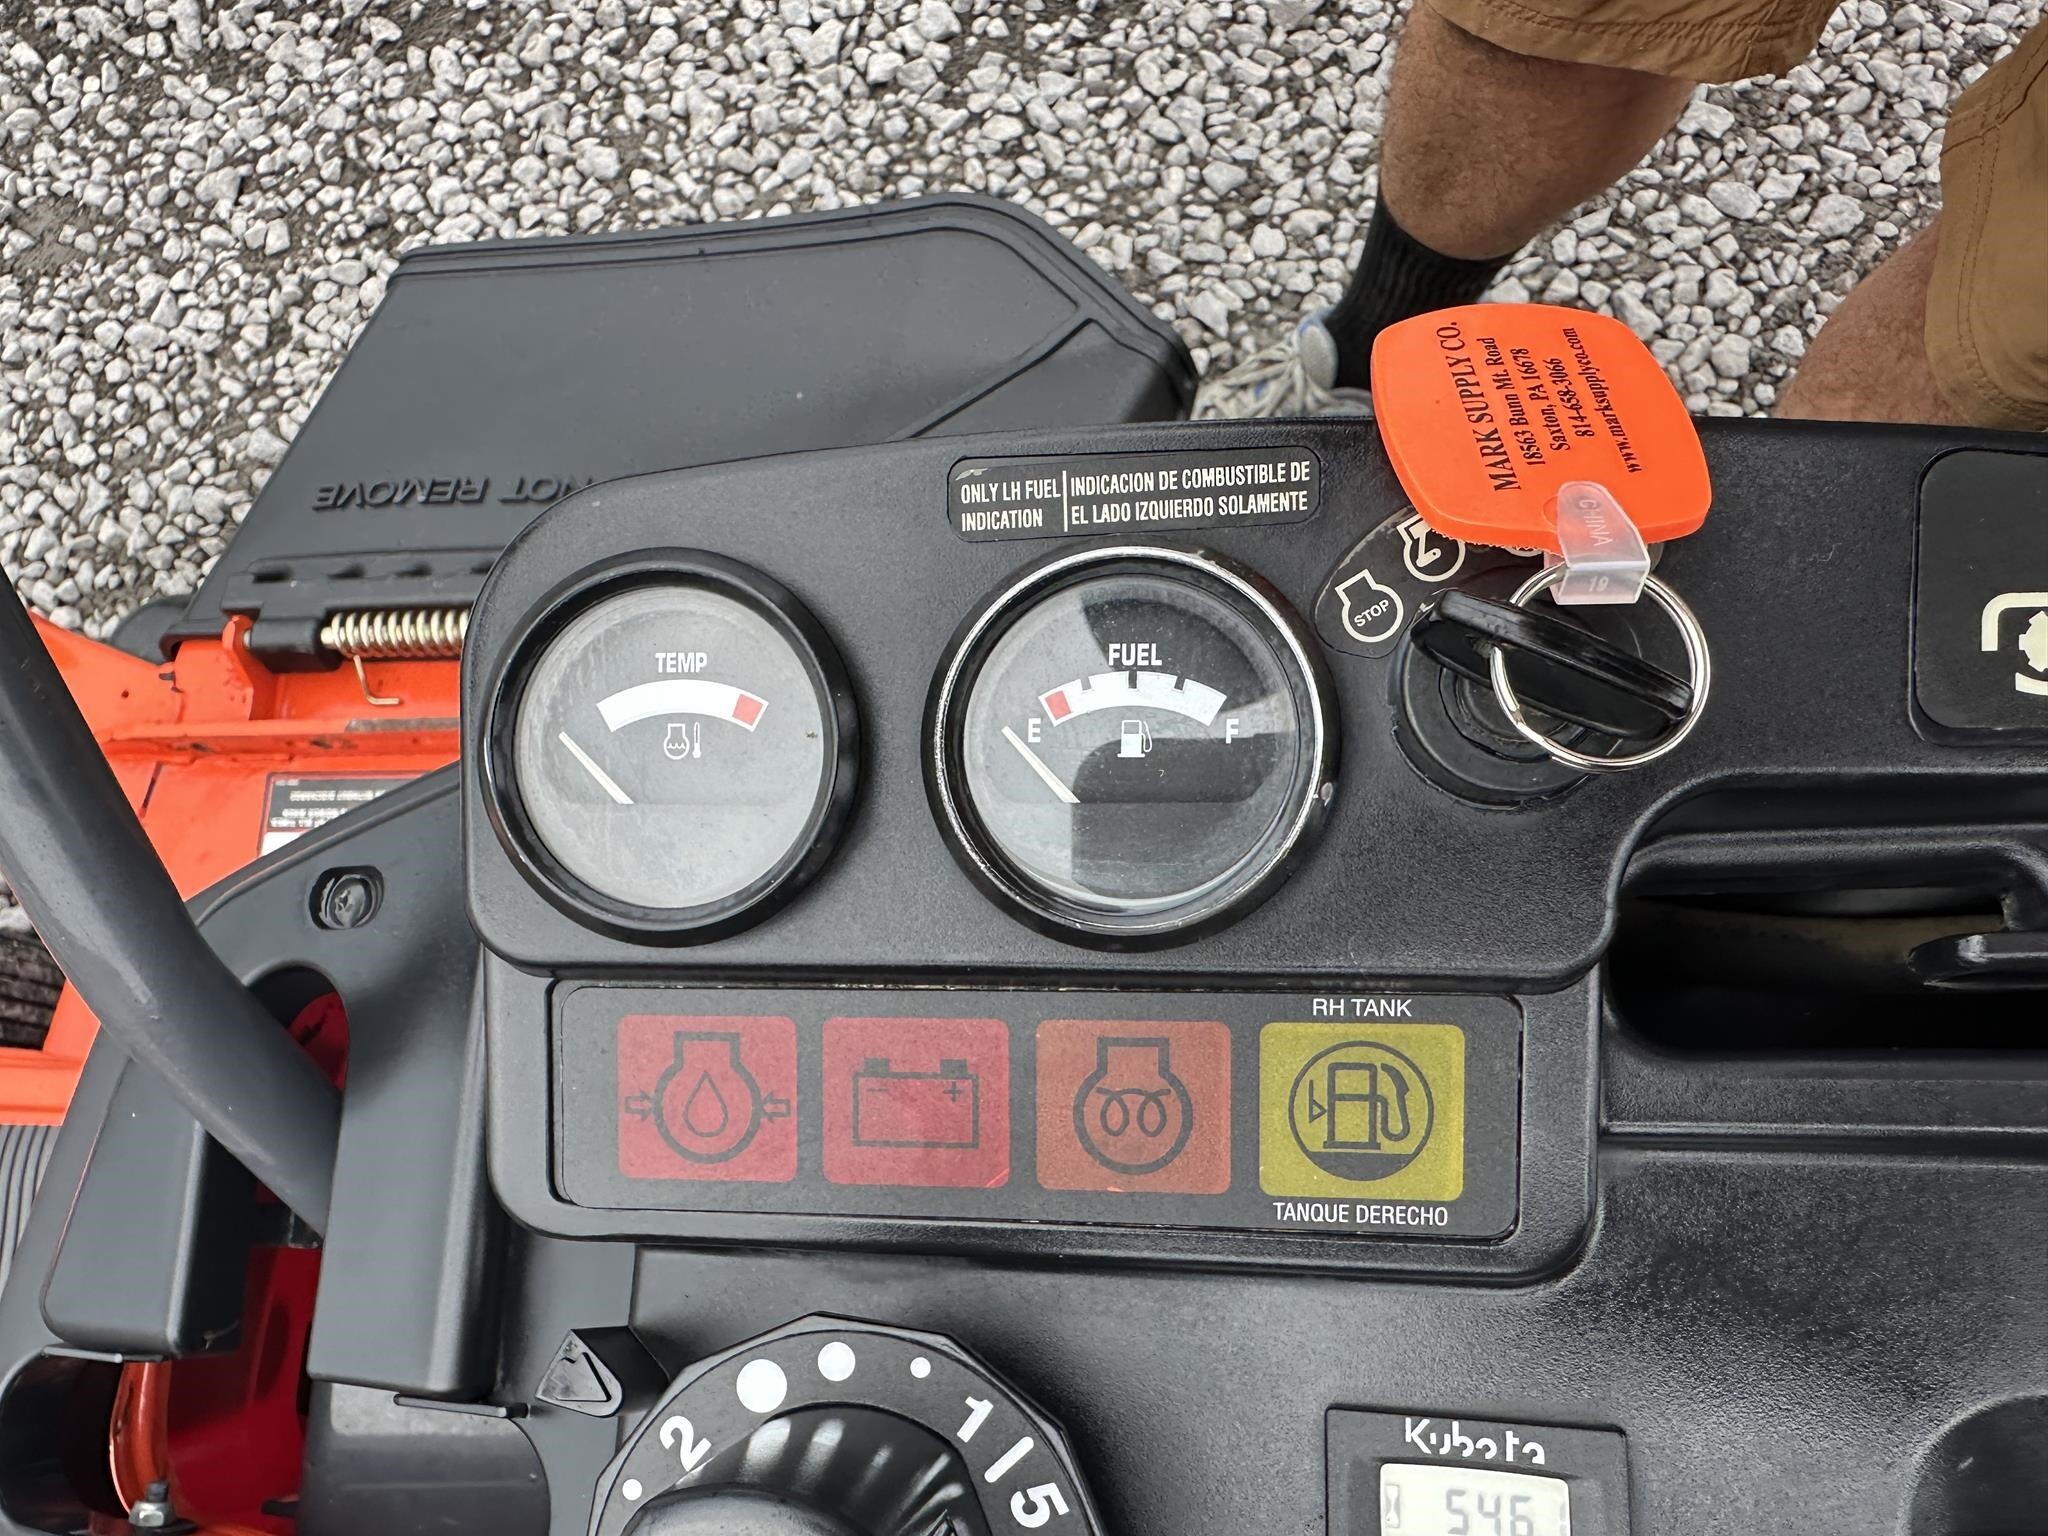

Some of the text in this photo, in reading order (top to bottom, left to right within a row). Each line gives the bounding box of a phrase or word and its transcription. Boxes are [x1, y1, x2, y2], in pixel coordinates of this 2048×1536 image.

[1476, 337, 1505, 366] Road
[1437, 321, 1521, 491] MARK SUPPLY CO.
[1505, 393, 1529, 426] Bunn
[1510, 348, 1571, 451] Saxton, PA 16678
[1542, 358, 1595, 437] 814-658-3066
[1562, 327, 1642, 473] www.marksupplyco.com
[1513, 429, 1546, 466] 18563
[312, 477, 490, 512] REMOVE
[961, 478, 1061, 504] ONLY LH FUEL
[1070, 461, 1311, 497] INDICACION DE COMBUSTIBLE DE
[961, 508, 1043, 532] INDICATION
[1071, 490, 1308, 525] EL LADO IZQUIERDO SOLAMENTE
[1577, 495, 1613, 547] CHINA
[1354, 599, 1390, 627] STOP
[655, 652, 708, 673] TEMP
[1108, 643, 1162, 666] FUEL
[1027, 717, 1041, 743] E
[1225, 718, 1239, 744] F
[1312, 998, 1412, 1017] RH TANK
[1273, 1202, 1448, 1226] TANQUE DERECHO
[949, 1395, 994, 1443] 1
[658, 1414, 712, 1471] 2
[1404, 1416, 1545, 1465] Kubota
[1010, 1481, 1069, 1529] 5
